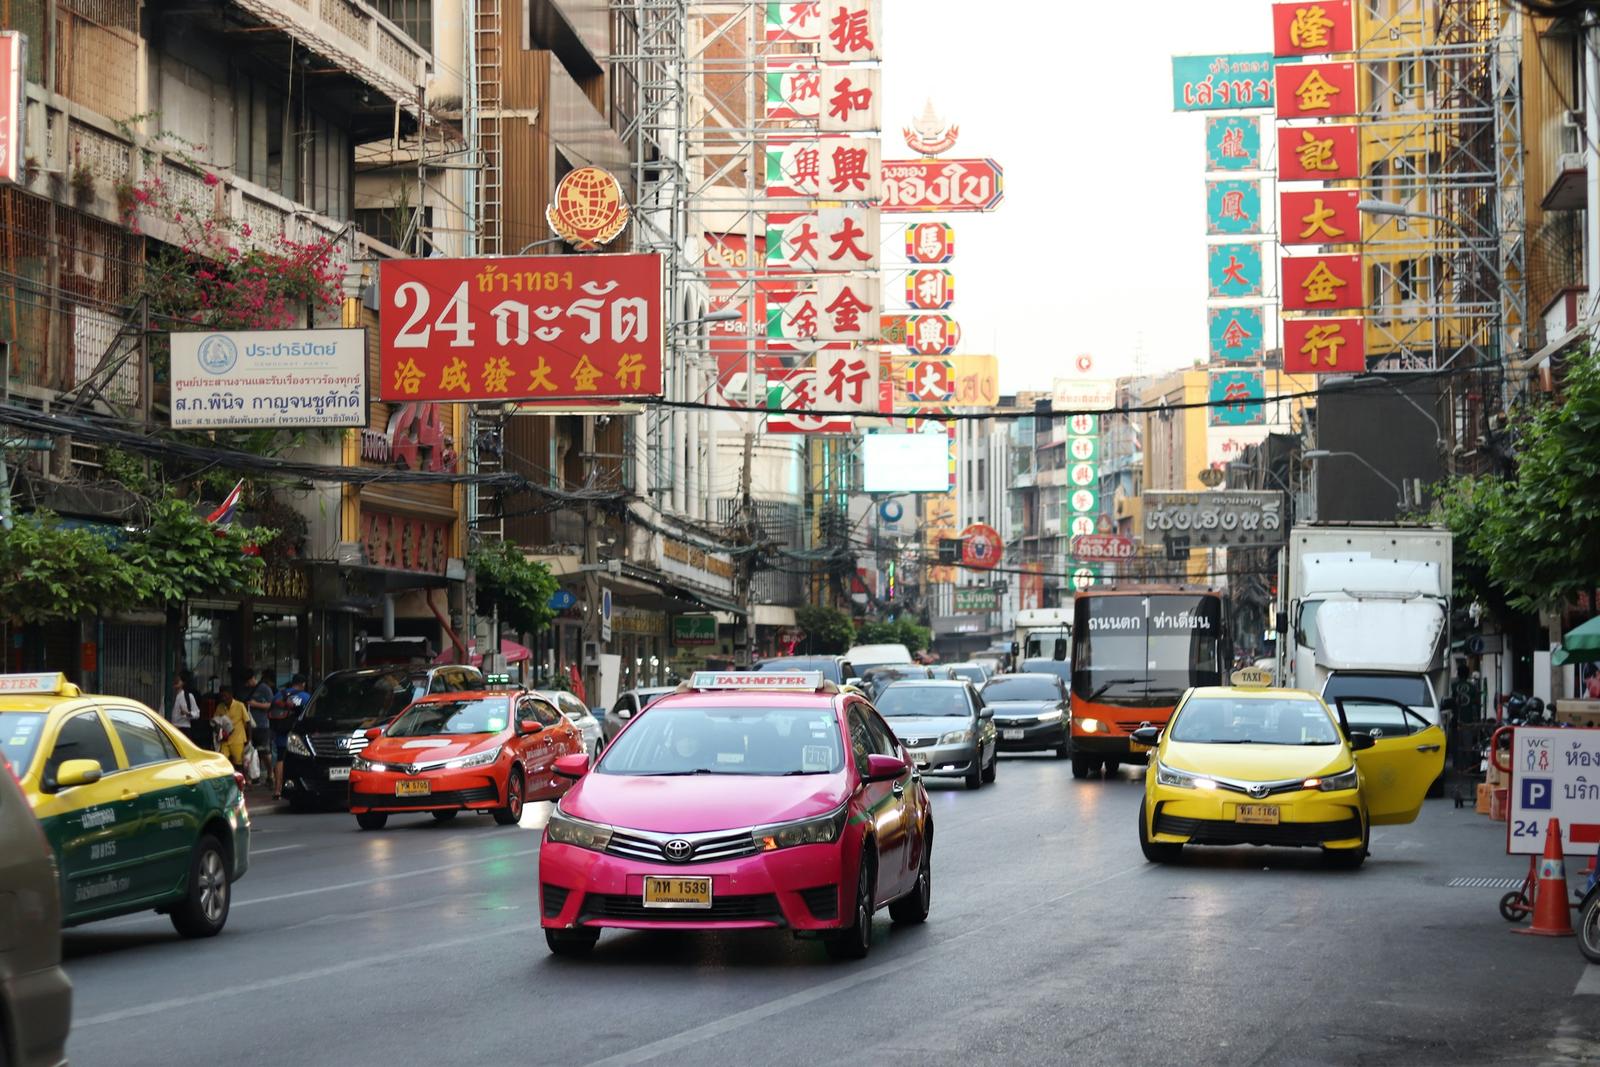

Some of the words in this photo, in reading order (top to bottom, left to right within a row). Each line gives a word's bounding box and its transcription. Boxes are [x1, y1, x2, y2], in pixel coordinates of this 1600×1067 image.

[1184, 74, 1274, 105] เล่งหง
[824, 6, 876, 404] 振和興大金行
[476, 264, 574, 293] ห้างทอง
[393, 281, 475, 348] 24
[490, 279, 649, 346] กะรัต
[246, 341, 338, 357] ประชาธิปัตย์
[176, 392, 245, 411] ส.ก.พินิจ
[1141, 597, 1149, 619] 1
[1087, 615, 1141, 631] ถนนตก
[1153, 610, 1211, 630] ท่าเตียน
[1241, 672, 1262, 682] TAXI
[1527, 739, 1549, 748] WC
[1529, 783, 1546, 806] P
[1513, 820, 1539, 837] 24
[678, 881, 708, 895] 1539
